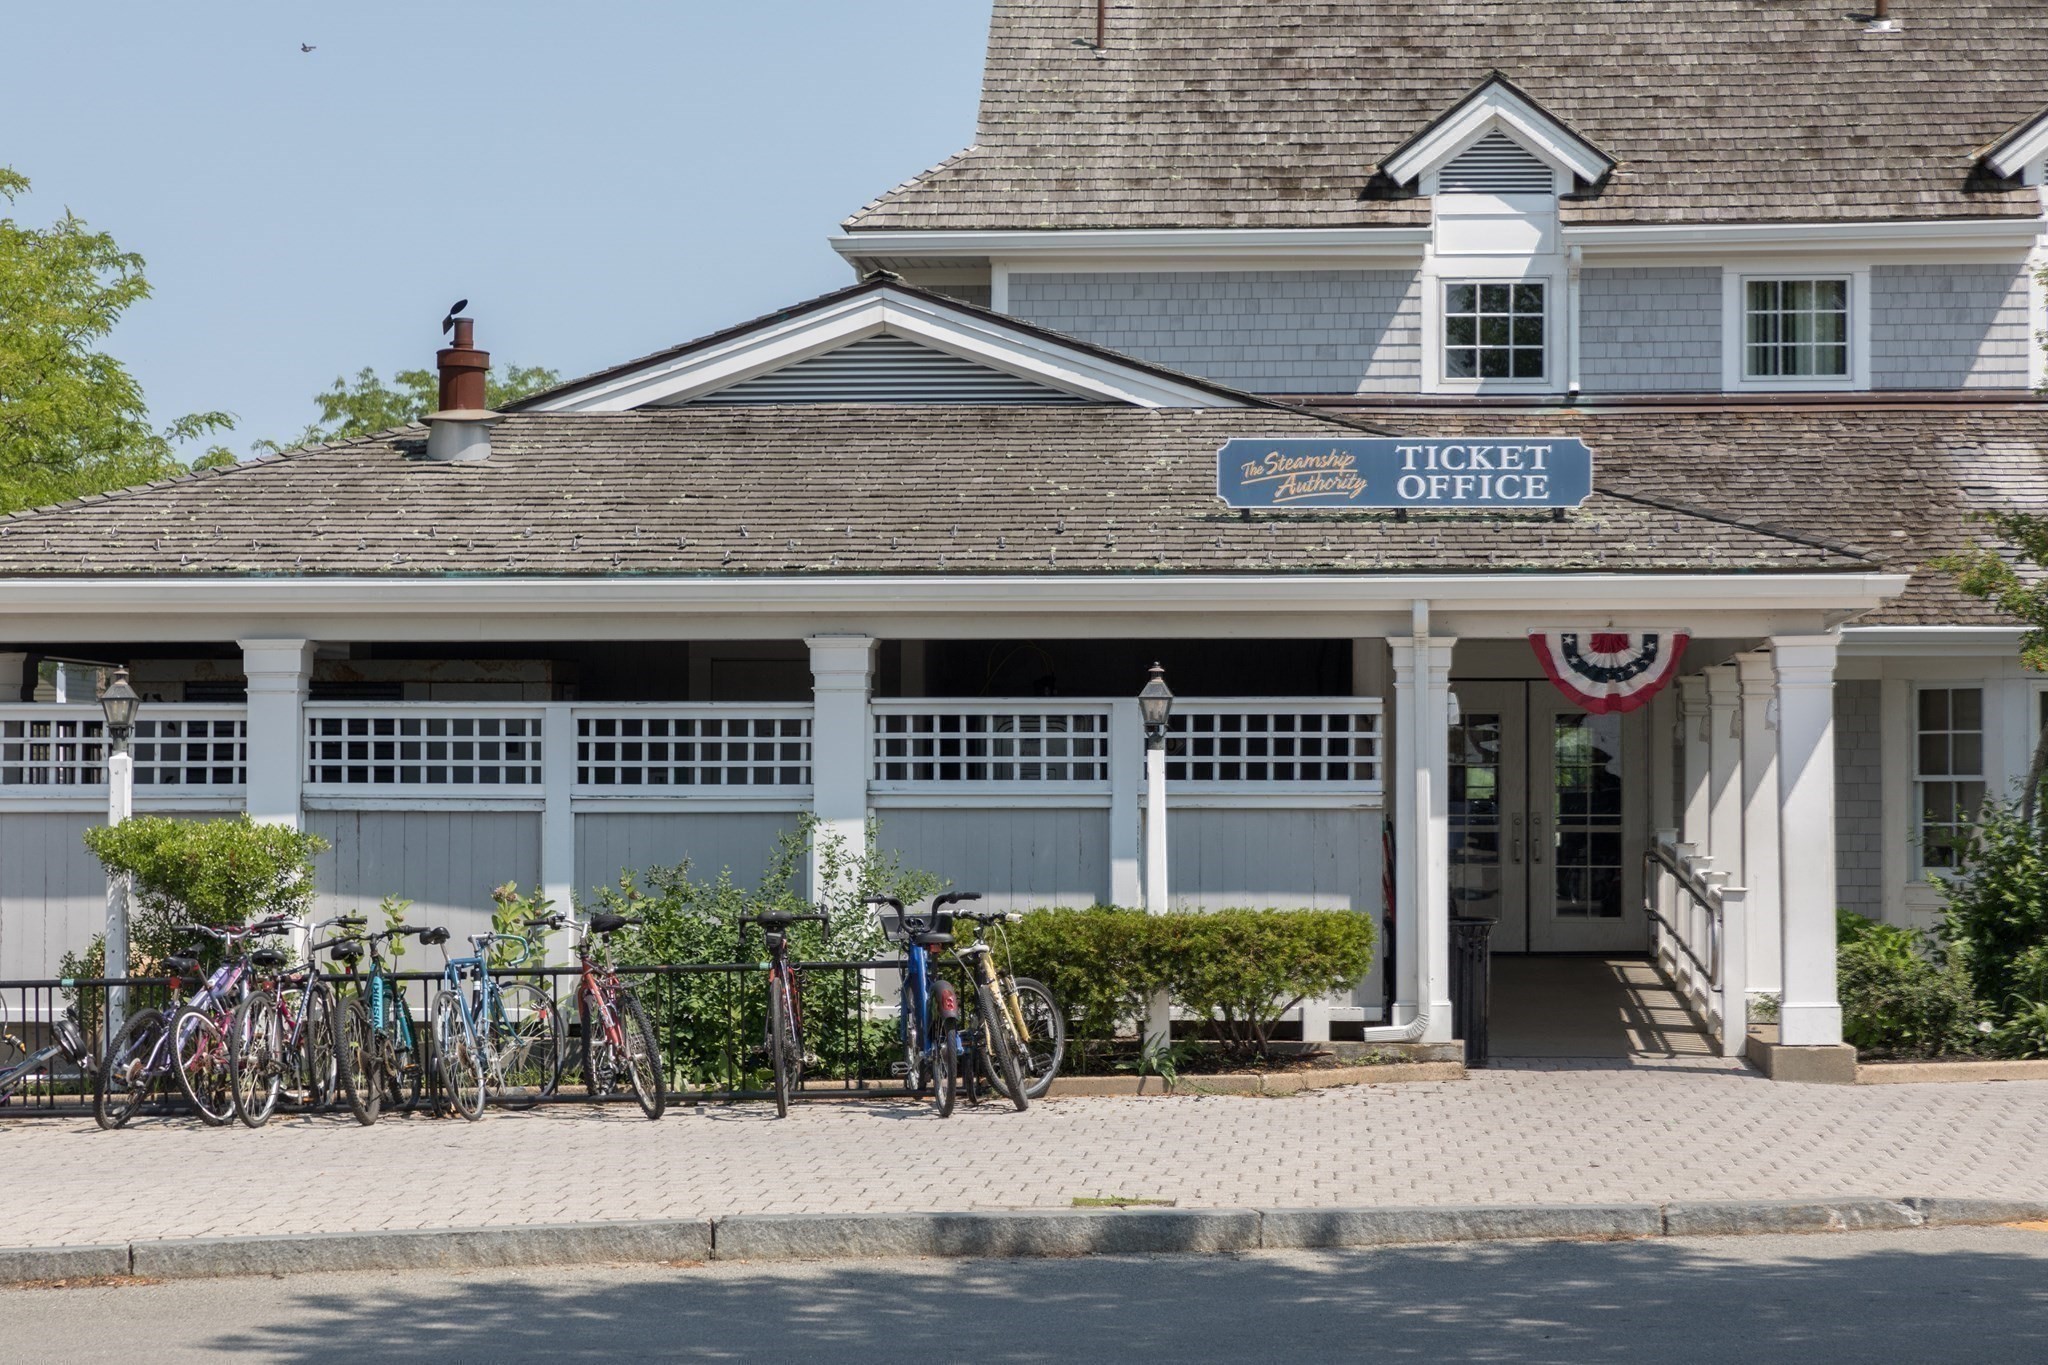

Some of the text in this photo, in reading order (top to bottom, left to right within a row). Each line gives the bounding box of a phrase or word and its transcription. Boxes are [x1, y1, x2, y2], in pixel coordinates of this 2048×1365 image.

[1241, 448, 1357, 478] The Steamship
[1395, 445, 1552, 470] TICKET
[1274, 472, 1368, 499] Authority
[1396, 474, 1550, 500] OFFICE
